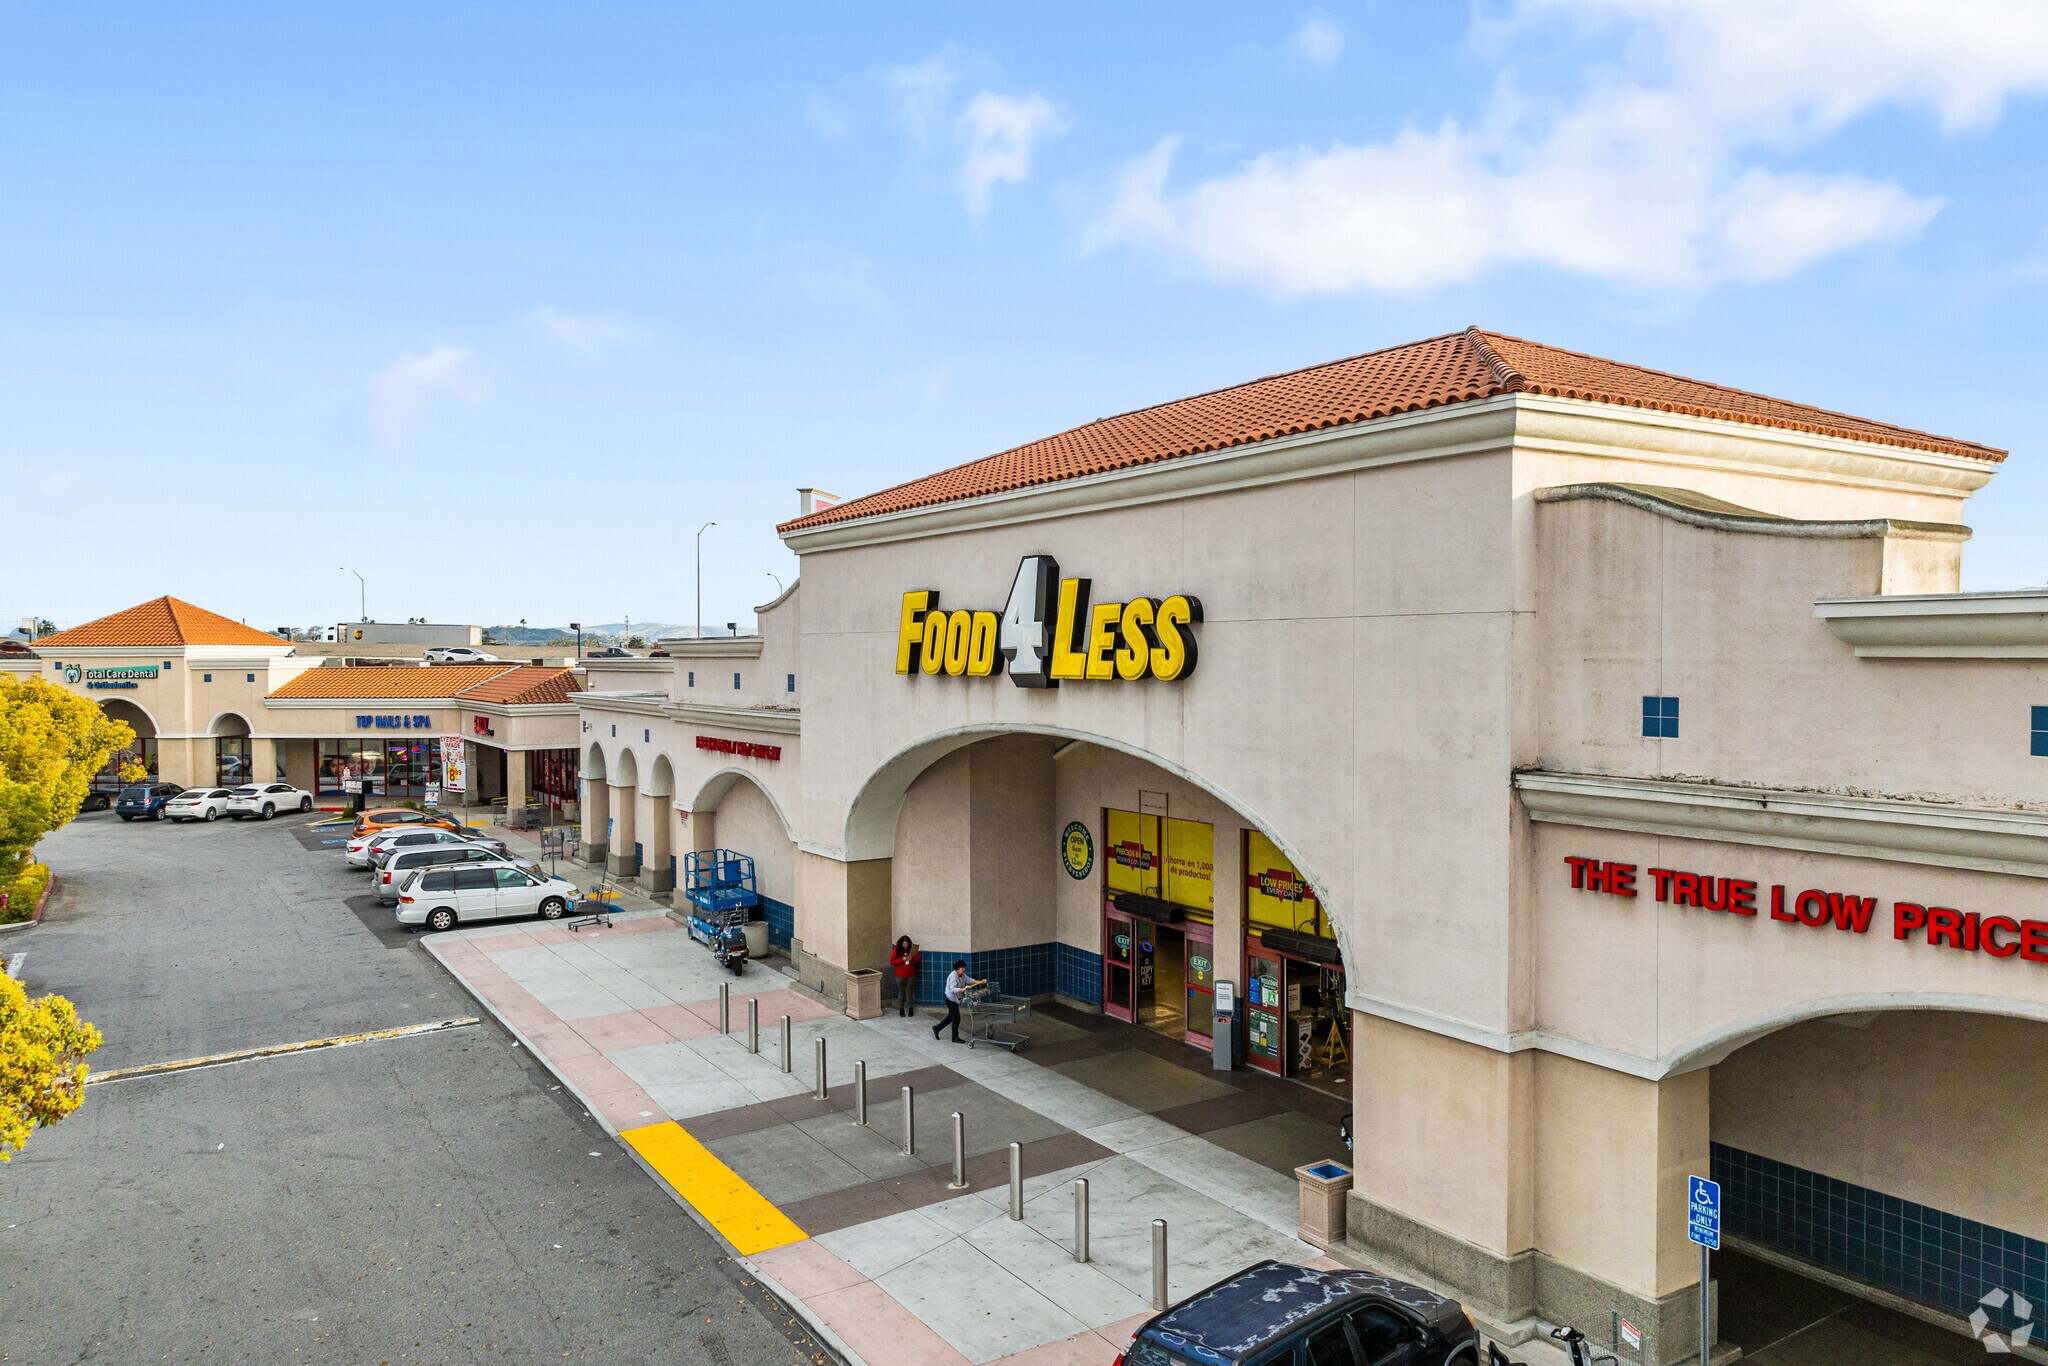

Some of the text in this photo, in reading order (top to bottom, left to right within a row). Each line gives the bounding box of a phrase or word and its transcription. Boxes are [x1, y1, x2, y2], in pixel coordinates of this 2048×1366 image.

[1001, 555, 1060, 689] 4
[1051, 578, 1204, 682] LESS
[83, 668, 158, 679] Total Care Dental
[356, 715, 432, 728] TOP NAILS & SPA
[1070, 835, 1084, 846] OPEN
[1115, 847, 1135, 857] PRECIOS
[1187, 860, 1195, 868] en
[1170, 865, 1211, 881] de productos!
[1260, 876, 1304, 893] LOW PRICES
[1266, 886, 1284, 896] EVERY
[1564, 856, 2048, 963] THE TRUE LOW PRICE
[1118, 937, 1130, 945] EXIT
[1193, 958, 1207, 967] EXIT
[1140, 965, 1154, 975] COPY
[1142, 976, 1153, 985] KEY
[1269, 994, 1275, 1002] A
[1690, 1202, 1718, 1219] PARKING
[1695, 1213, 1713, 1227] ONLY
